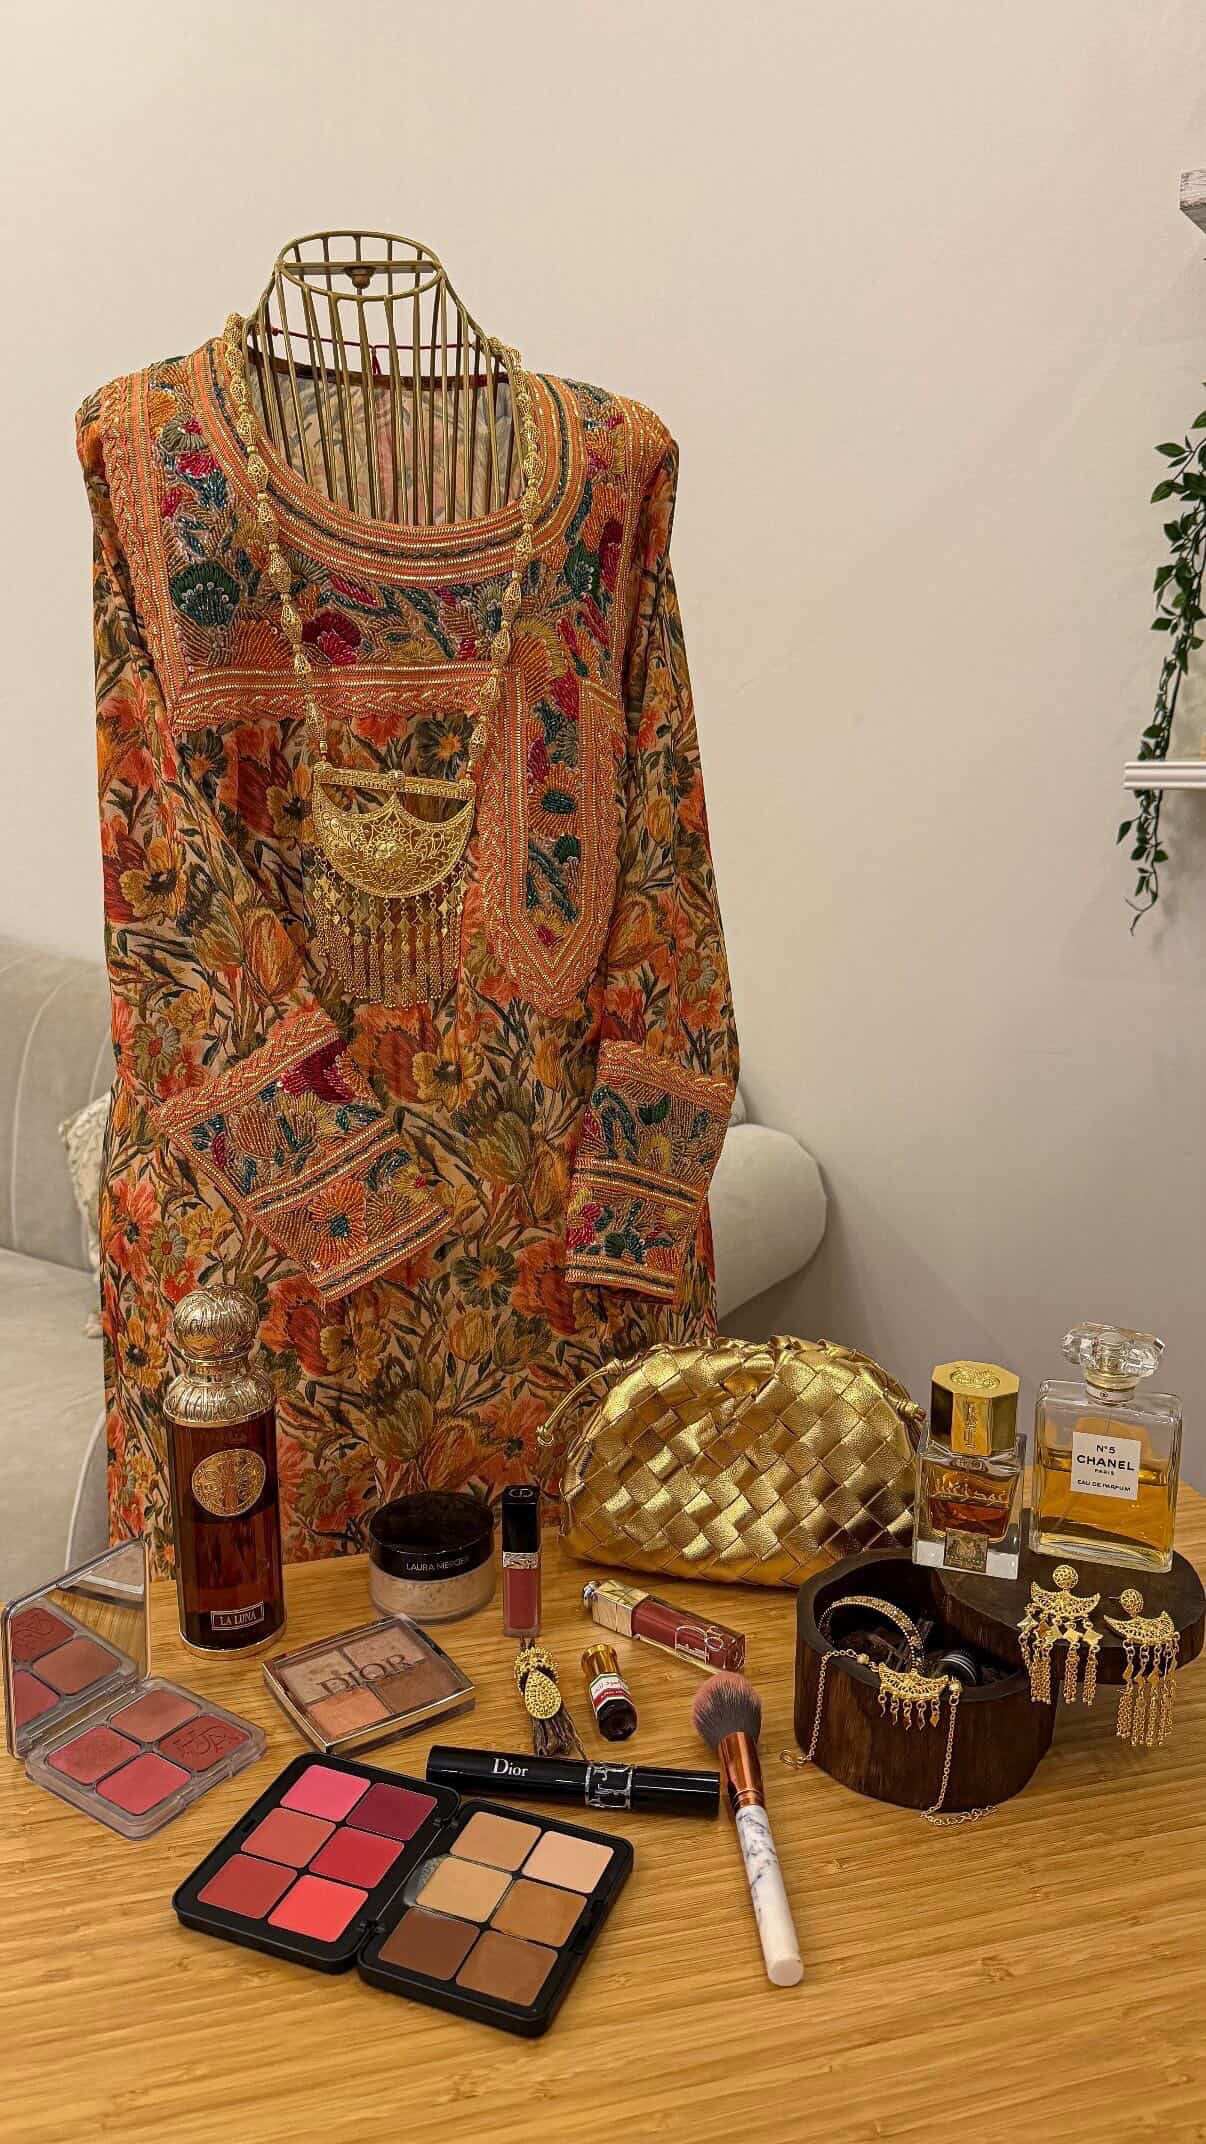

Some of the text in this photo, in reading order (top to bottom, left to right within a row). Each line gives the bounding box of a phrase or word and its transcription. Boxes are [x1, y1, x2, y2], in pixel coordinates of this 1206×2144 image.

[1077, 1455, 1135, 1471] CHANEL
[1102, 1483, 1131, 1492] PARFUM
[406, 1562, 434, 1572] LAURA
[219, 1610, 257, 1626] LA LUNA
[315, 1654, 417, 1695] DIOR
[492, 1757, 529, 1777] Dior
